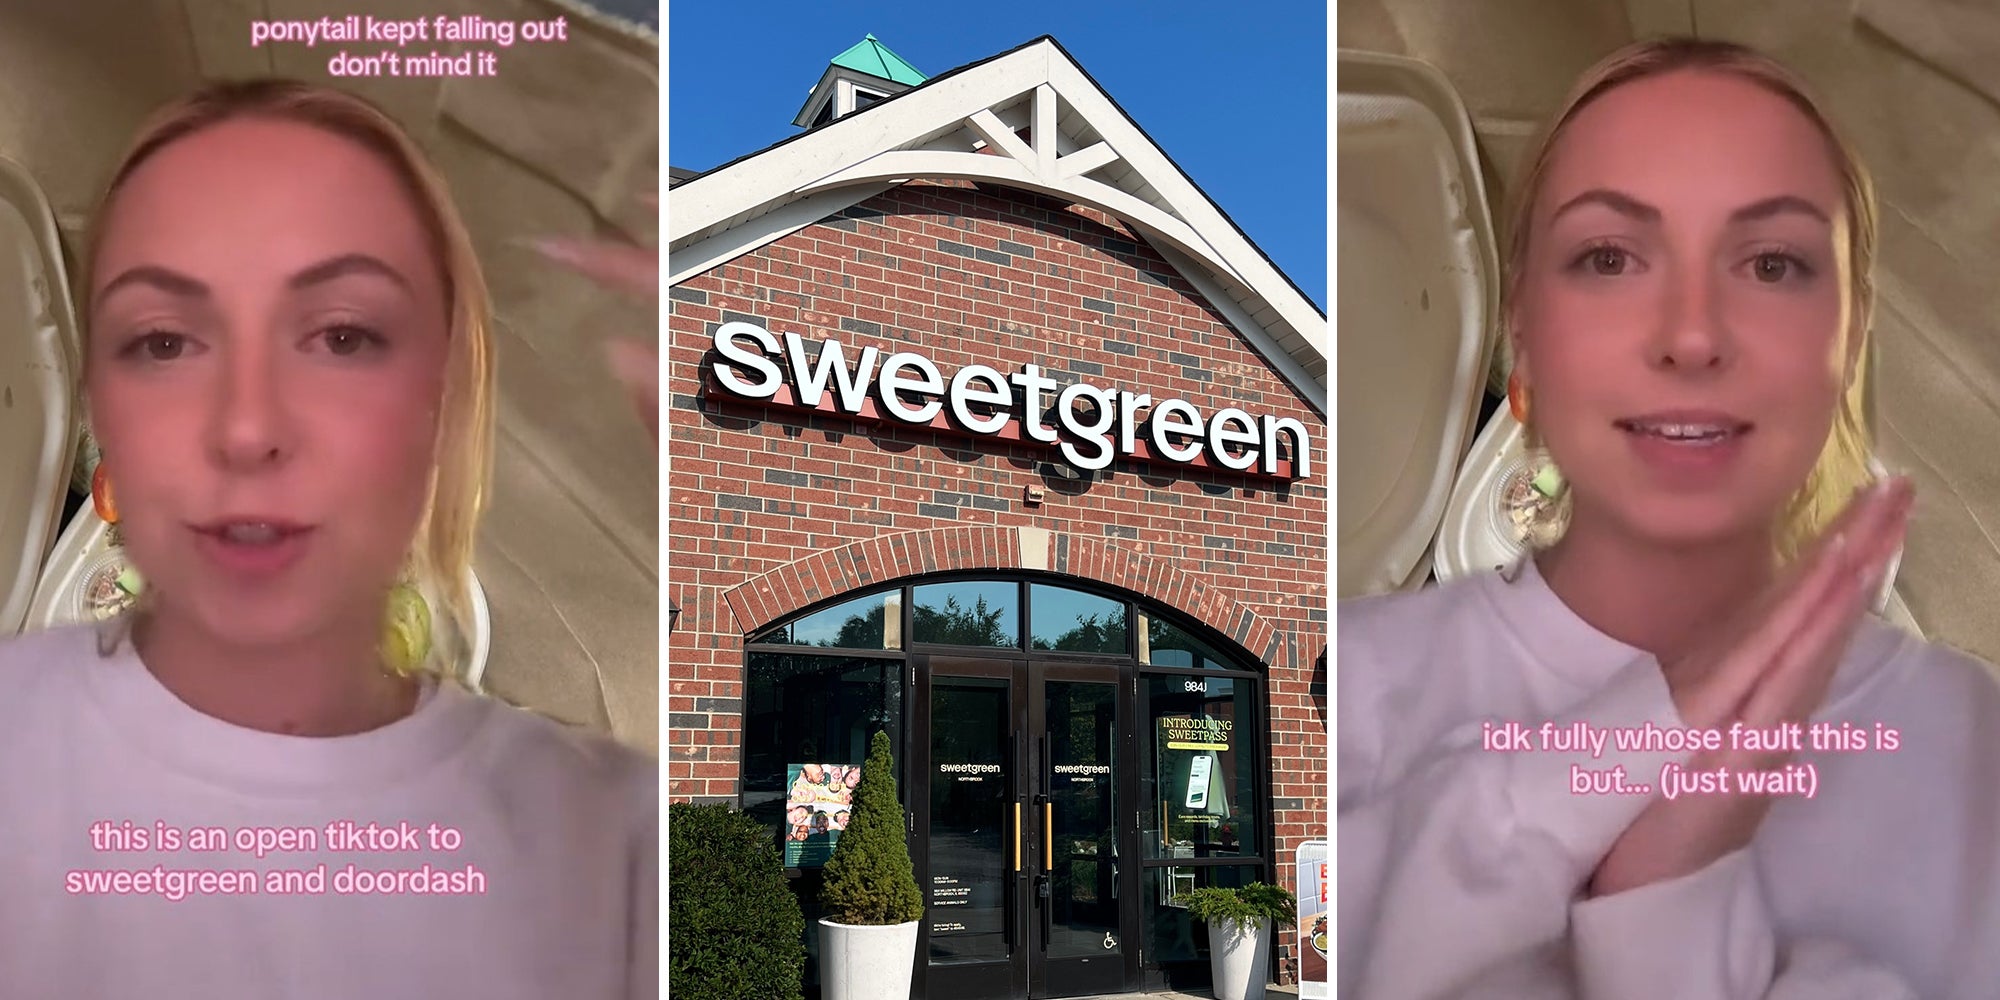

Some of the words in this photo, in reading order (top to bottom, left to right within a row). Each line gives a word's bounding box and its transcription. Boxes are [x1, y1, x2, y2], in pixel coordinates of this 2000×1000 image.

[712, 321, 1311, 480] sweetgreen
[1184, 681, 1207, 692] 984J
[1163, 717, 1232, 731] INTRODUCING
[1168, 729, 1228, 741] SWEETPASS
[940, 763, 1000, 775] sweetgreen
[1054, 764, 1110, 776] sweetgreen
